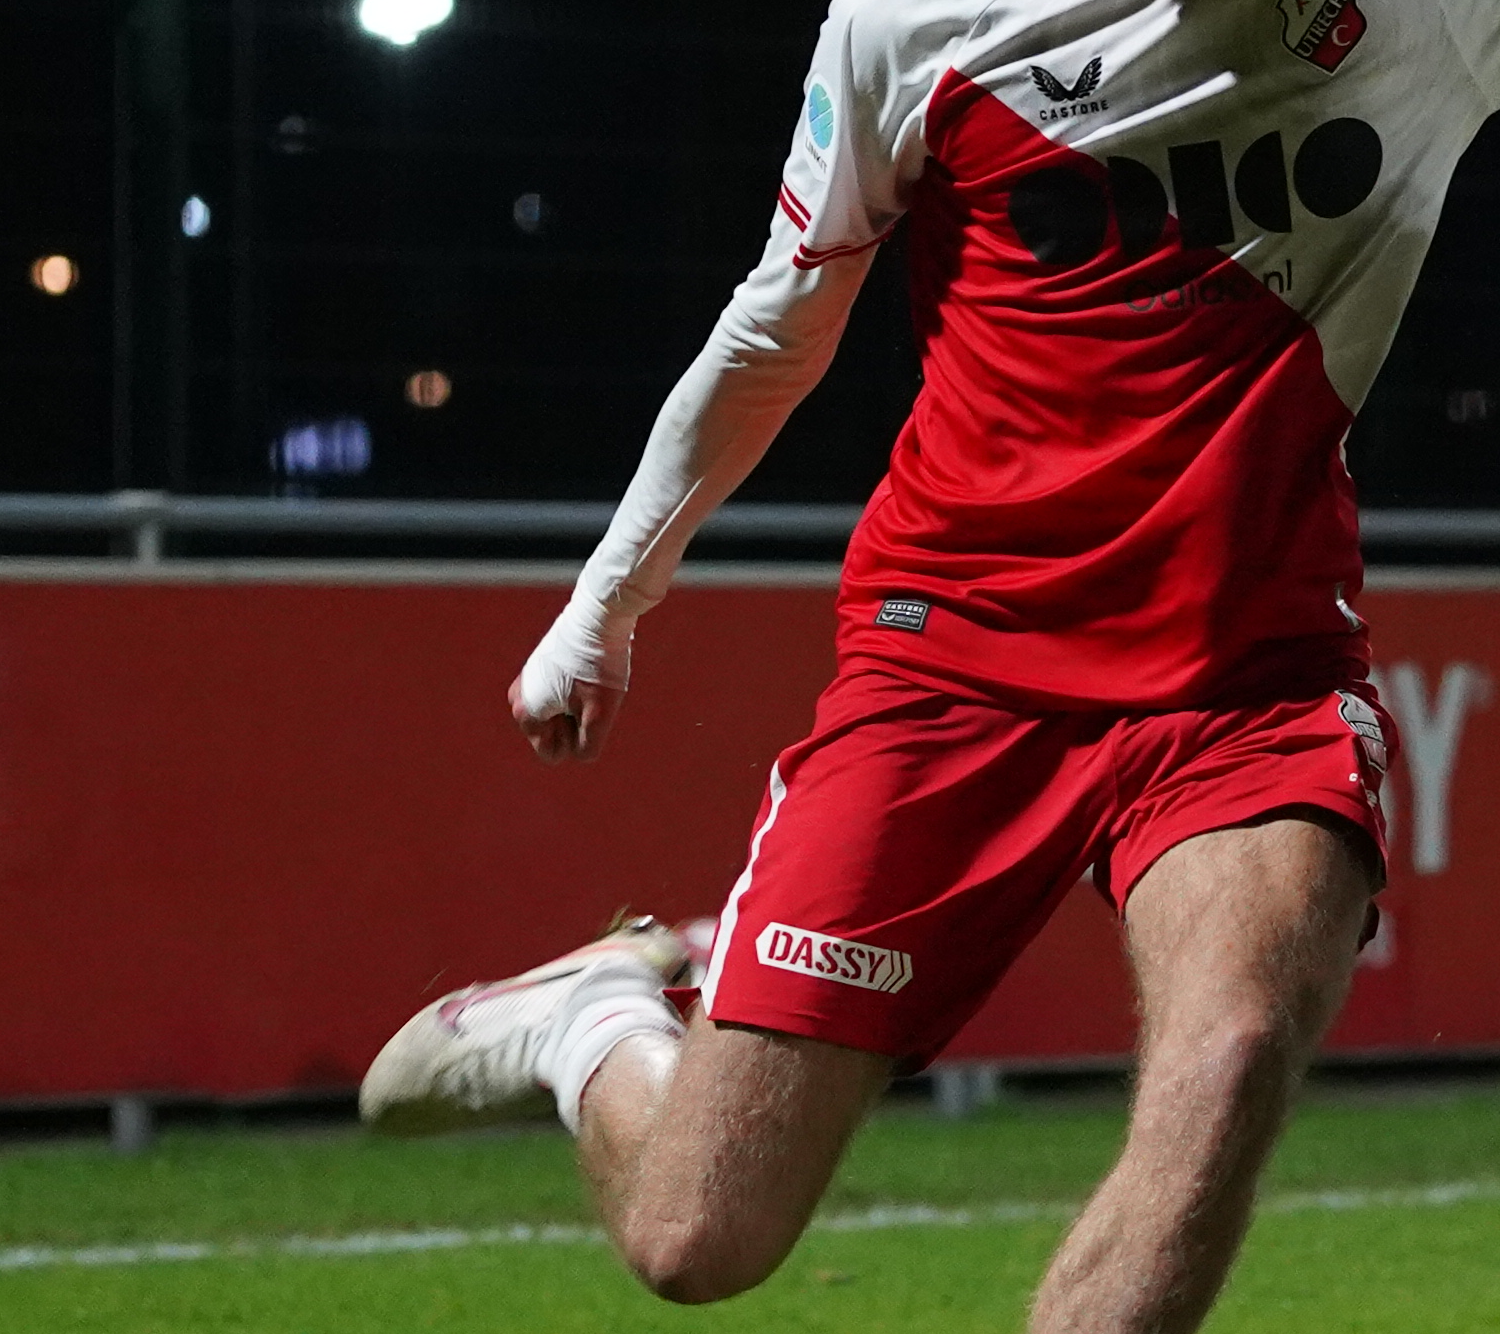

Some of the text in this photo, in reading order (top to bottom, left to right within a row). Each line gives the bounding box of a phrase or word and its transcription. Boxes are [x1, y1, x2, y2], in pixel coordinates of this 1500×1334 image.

[1331, 24, 1351, 47] C
[1039, 99, 1110, 121] CASTORE
[767, 929, 887, 984] DASSY
